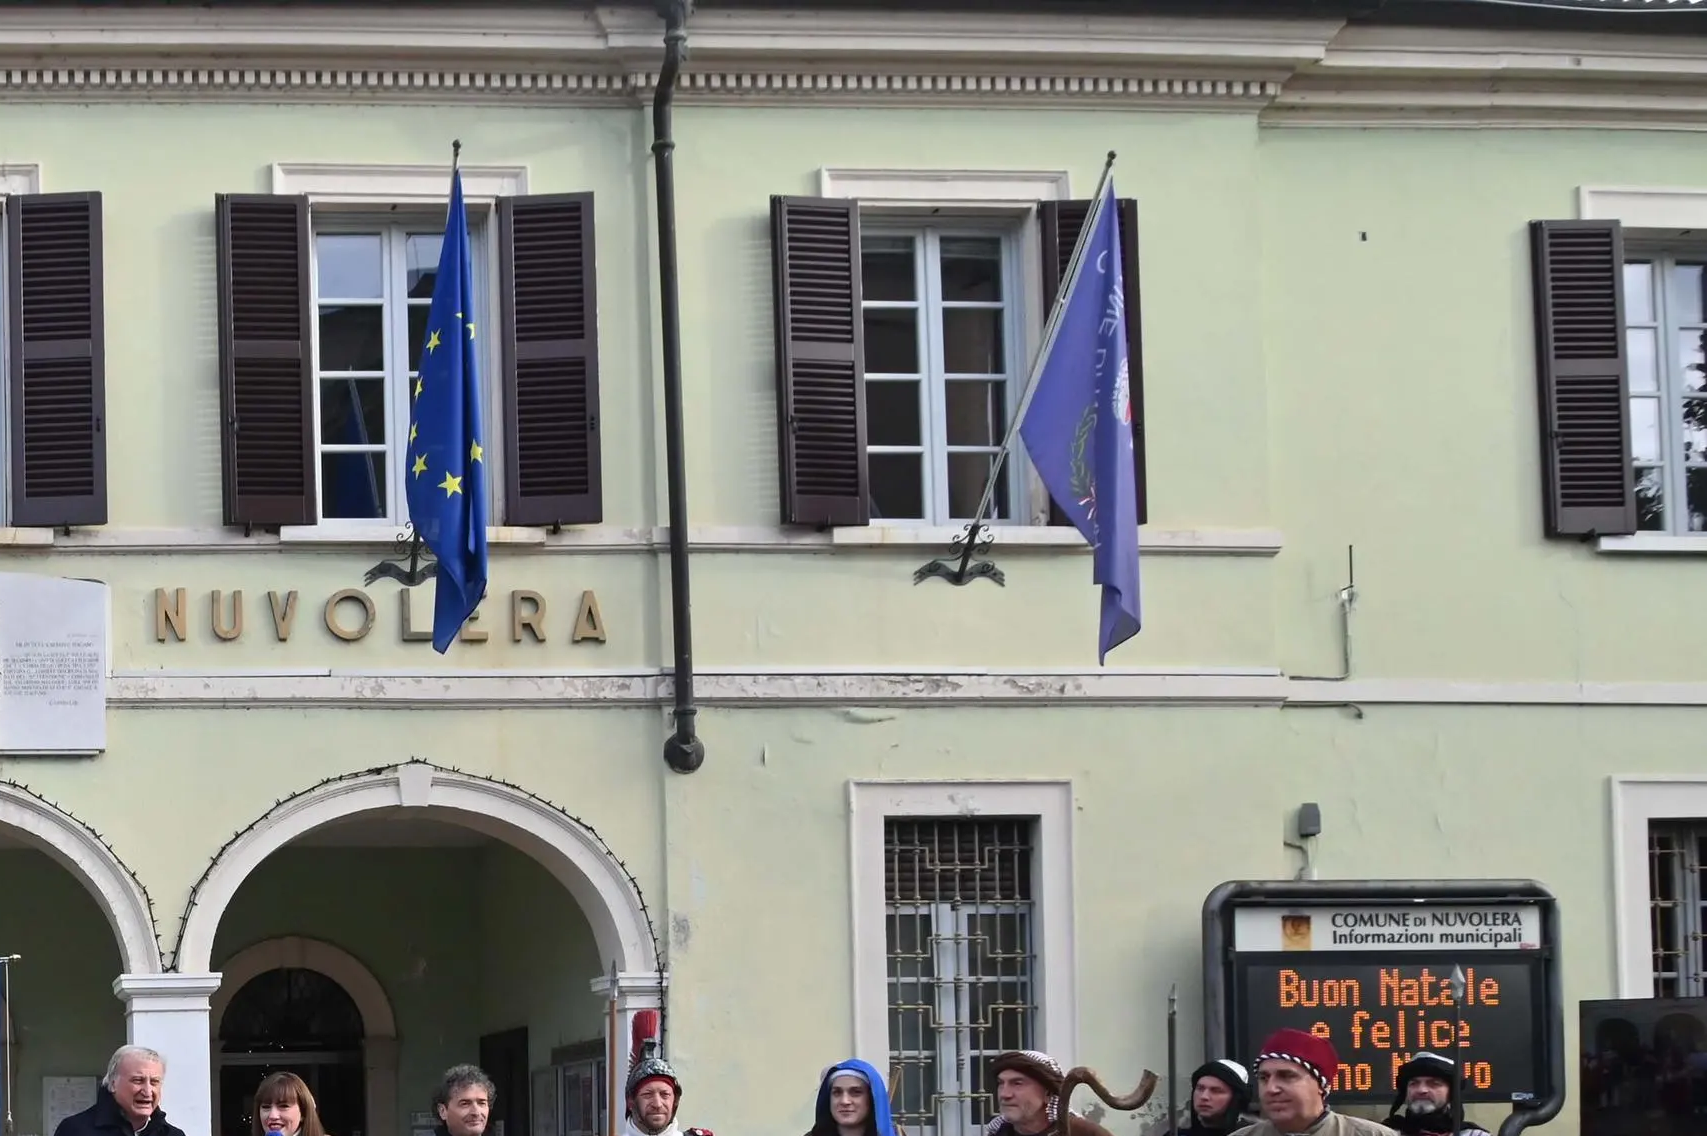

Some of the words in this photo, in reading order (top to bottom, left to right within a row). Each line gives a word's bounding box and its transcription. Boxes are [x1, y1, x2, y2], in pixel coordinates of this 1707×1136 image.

[1331, 912, 1410, 928] COMUNE
[1431, 911, 1522, 927] NUVOLERA
[1332, 928, 1434, 944] Informazioni
[1439, 928, 1522, 947] municipali
[1278, 969, 1360, 1008] Buon
[1379, 968, 1500, 1007] Natale
[1311, 1021, 1331, 1039] e
[1351, 1010, 1470, 1049] felice
